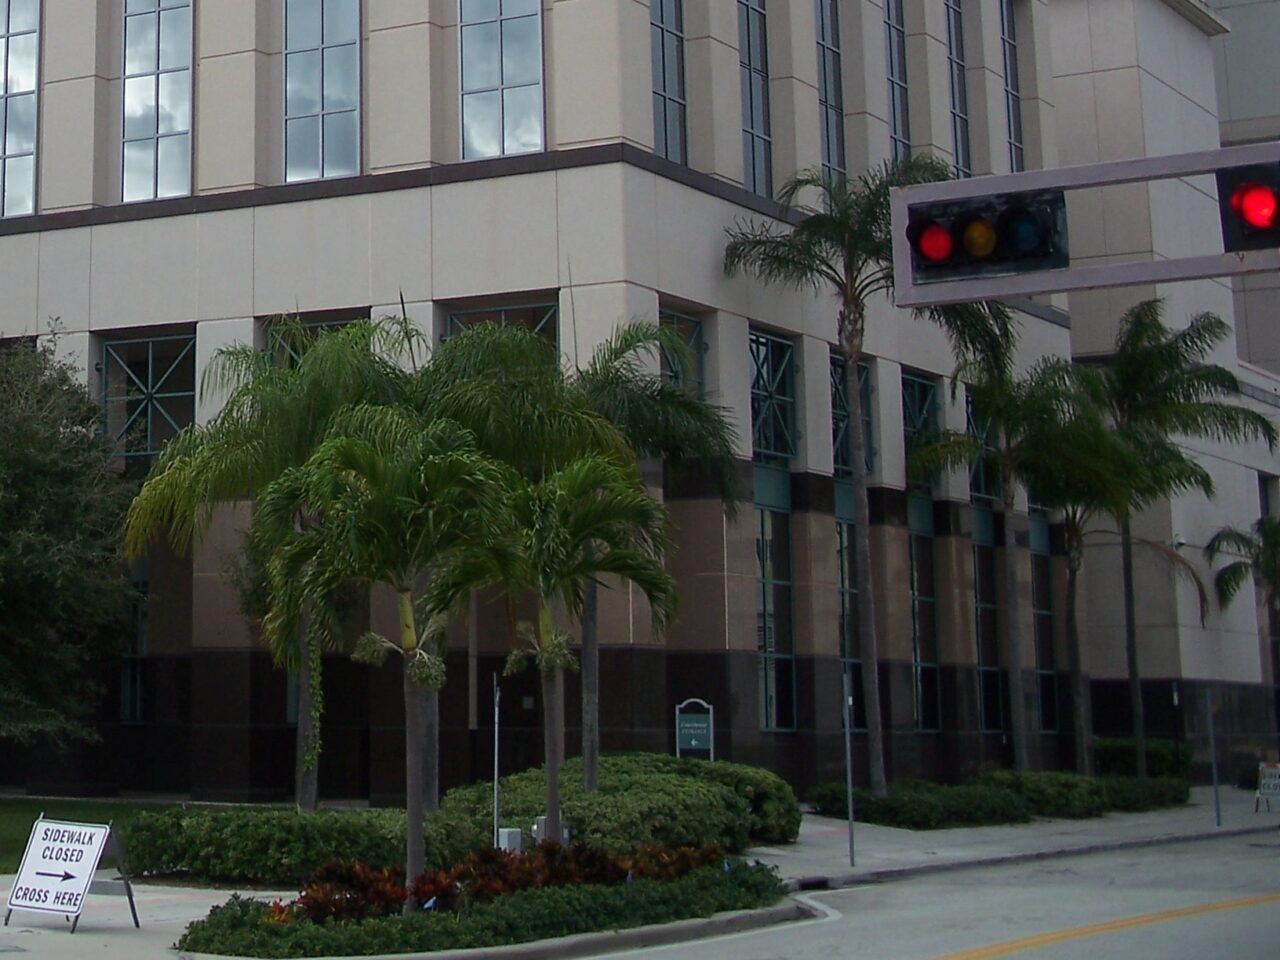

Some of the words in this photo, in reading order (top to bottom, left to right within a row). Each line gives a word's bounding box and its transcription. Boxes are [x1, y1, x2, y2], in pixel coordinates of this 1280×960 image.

[42, 828, 96, 846] SIDEWALK
[42, 846, 84, 863] CLOSED
[15, 886, 50, 903] CROSS
[53, 890, 81, 907] HERE
